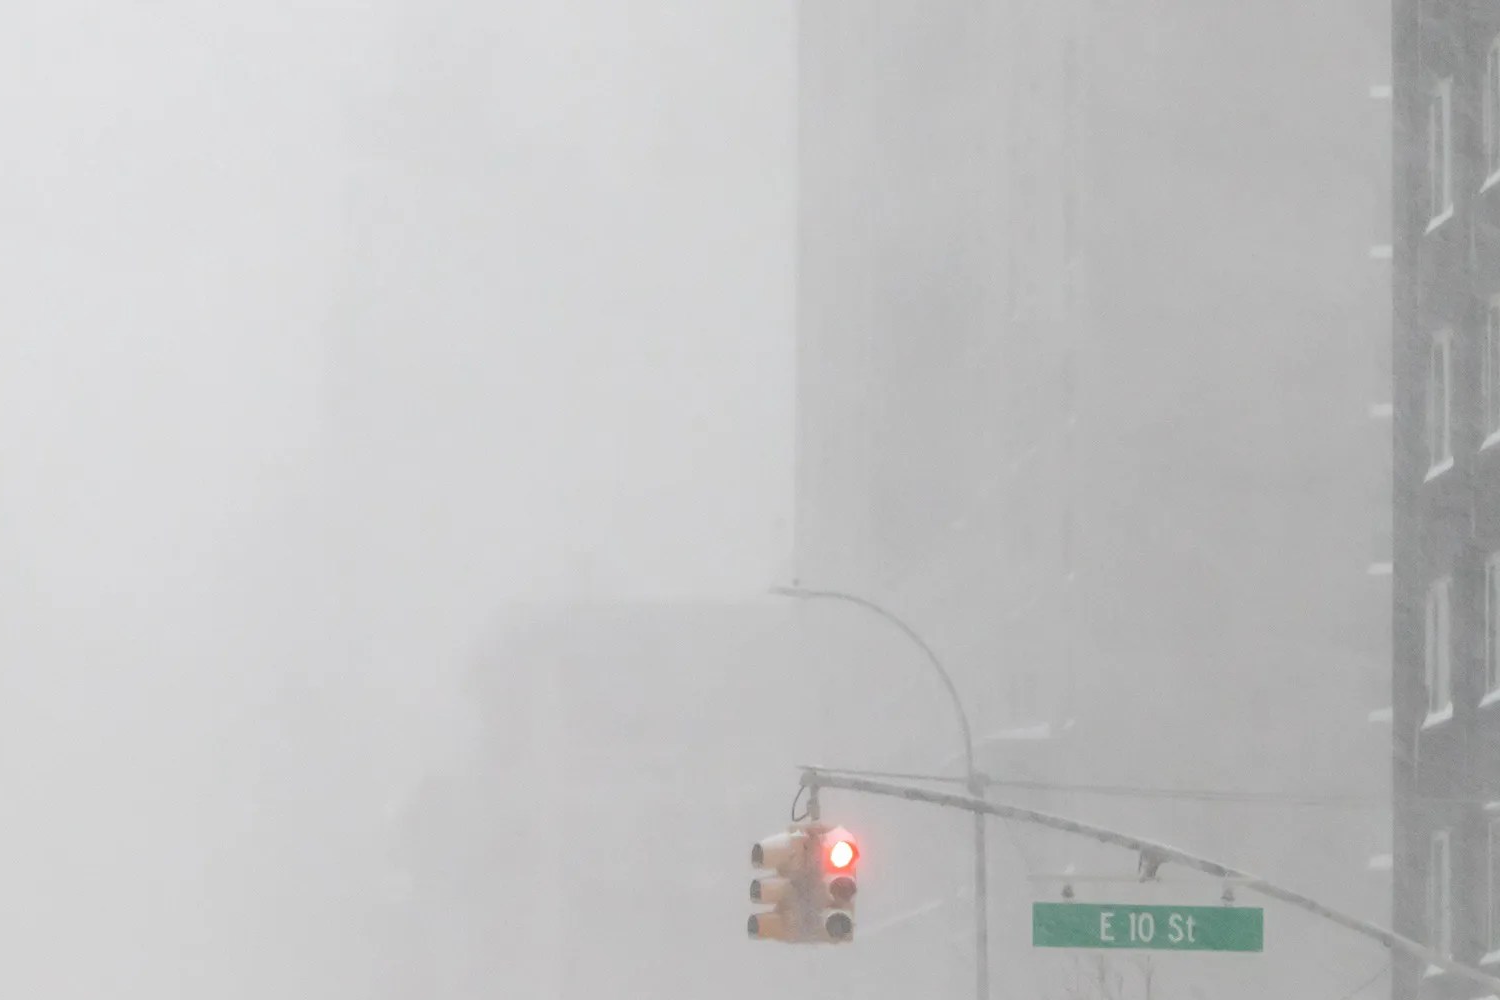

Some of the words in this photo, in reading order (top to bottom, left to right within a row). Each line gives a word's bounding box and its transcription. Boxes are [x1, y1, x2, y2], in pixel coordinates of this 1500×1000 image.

[1100, 911, 1115, 941] E
[1129, 911, 1156, 943] 10
[1168, 912, 1197, 944] St
